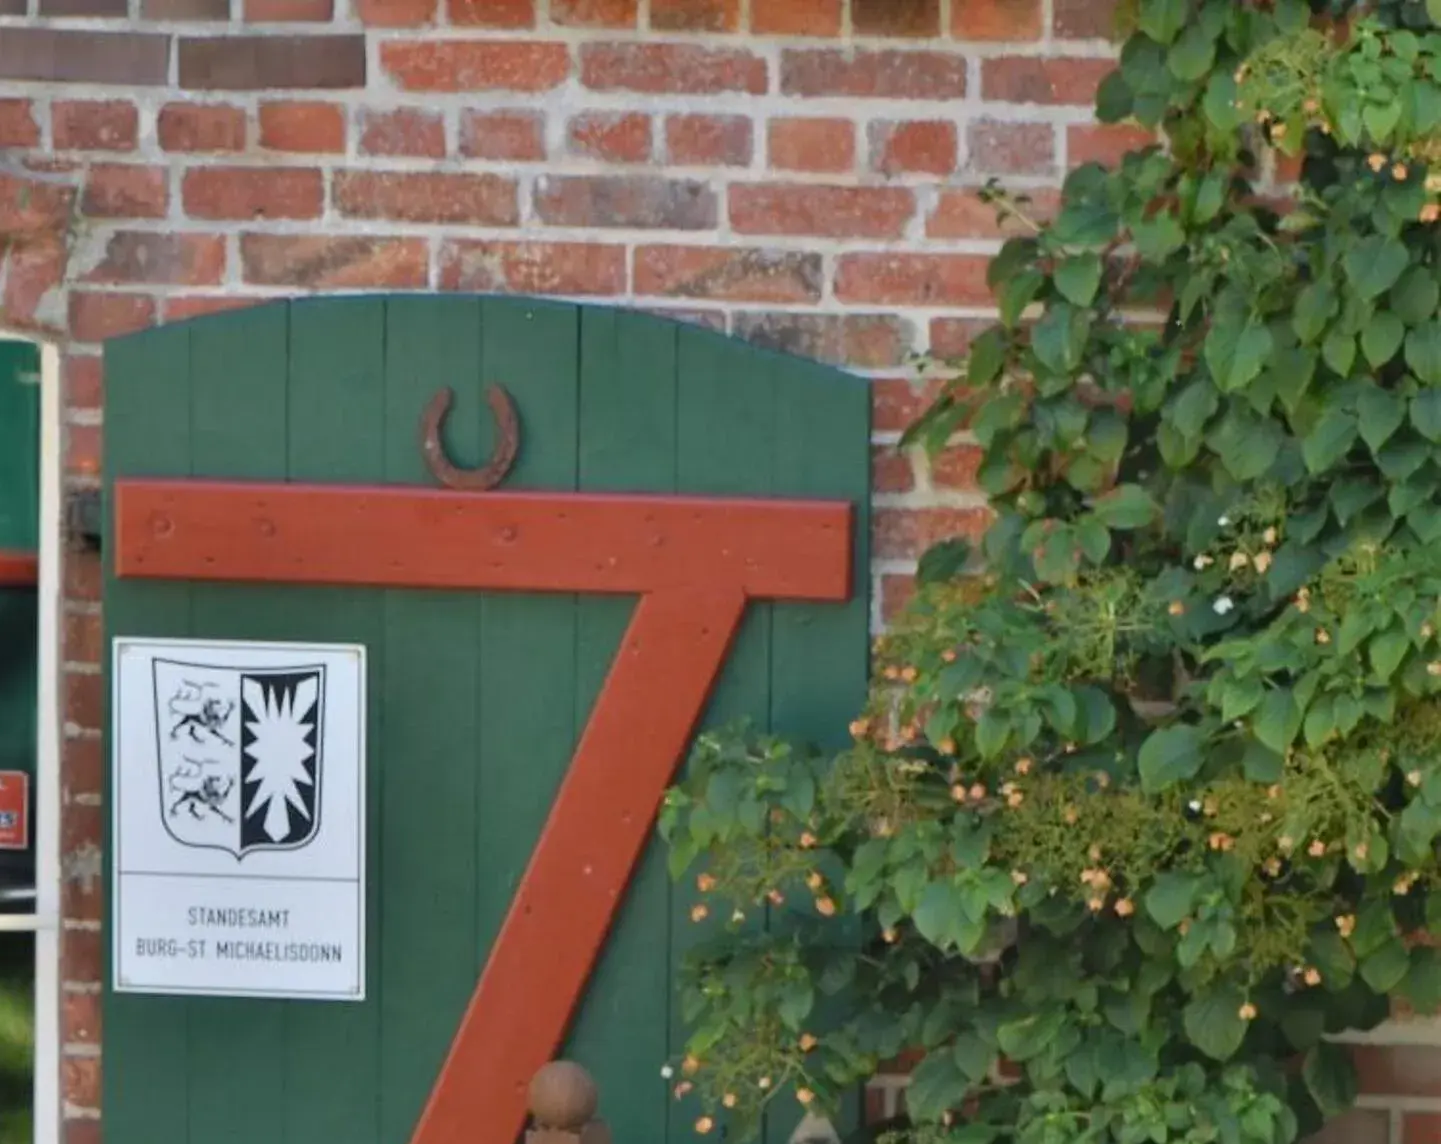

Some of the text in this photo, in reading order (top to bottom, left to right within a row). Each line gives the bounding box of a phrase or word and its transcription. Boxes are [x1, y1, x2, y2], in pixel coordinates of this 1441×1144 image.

[188, 906, 290, 929] STANDESAMT
[135, 937, 342, 964] BURG-ST MICHAELISDONN
